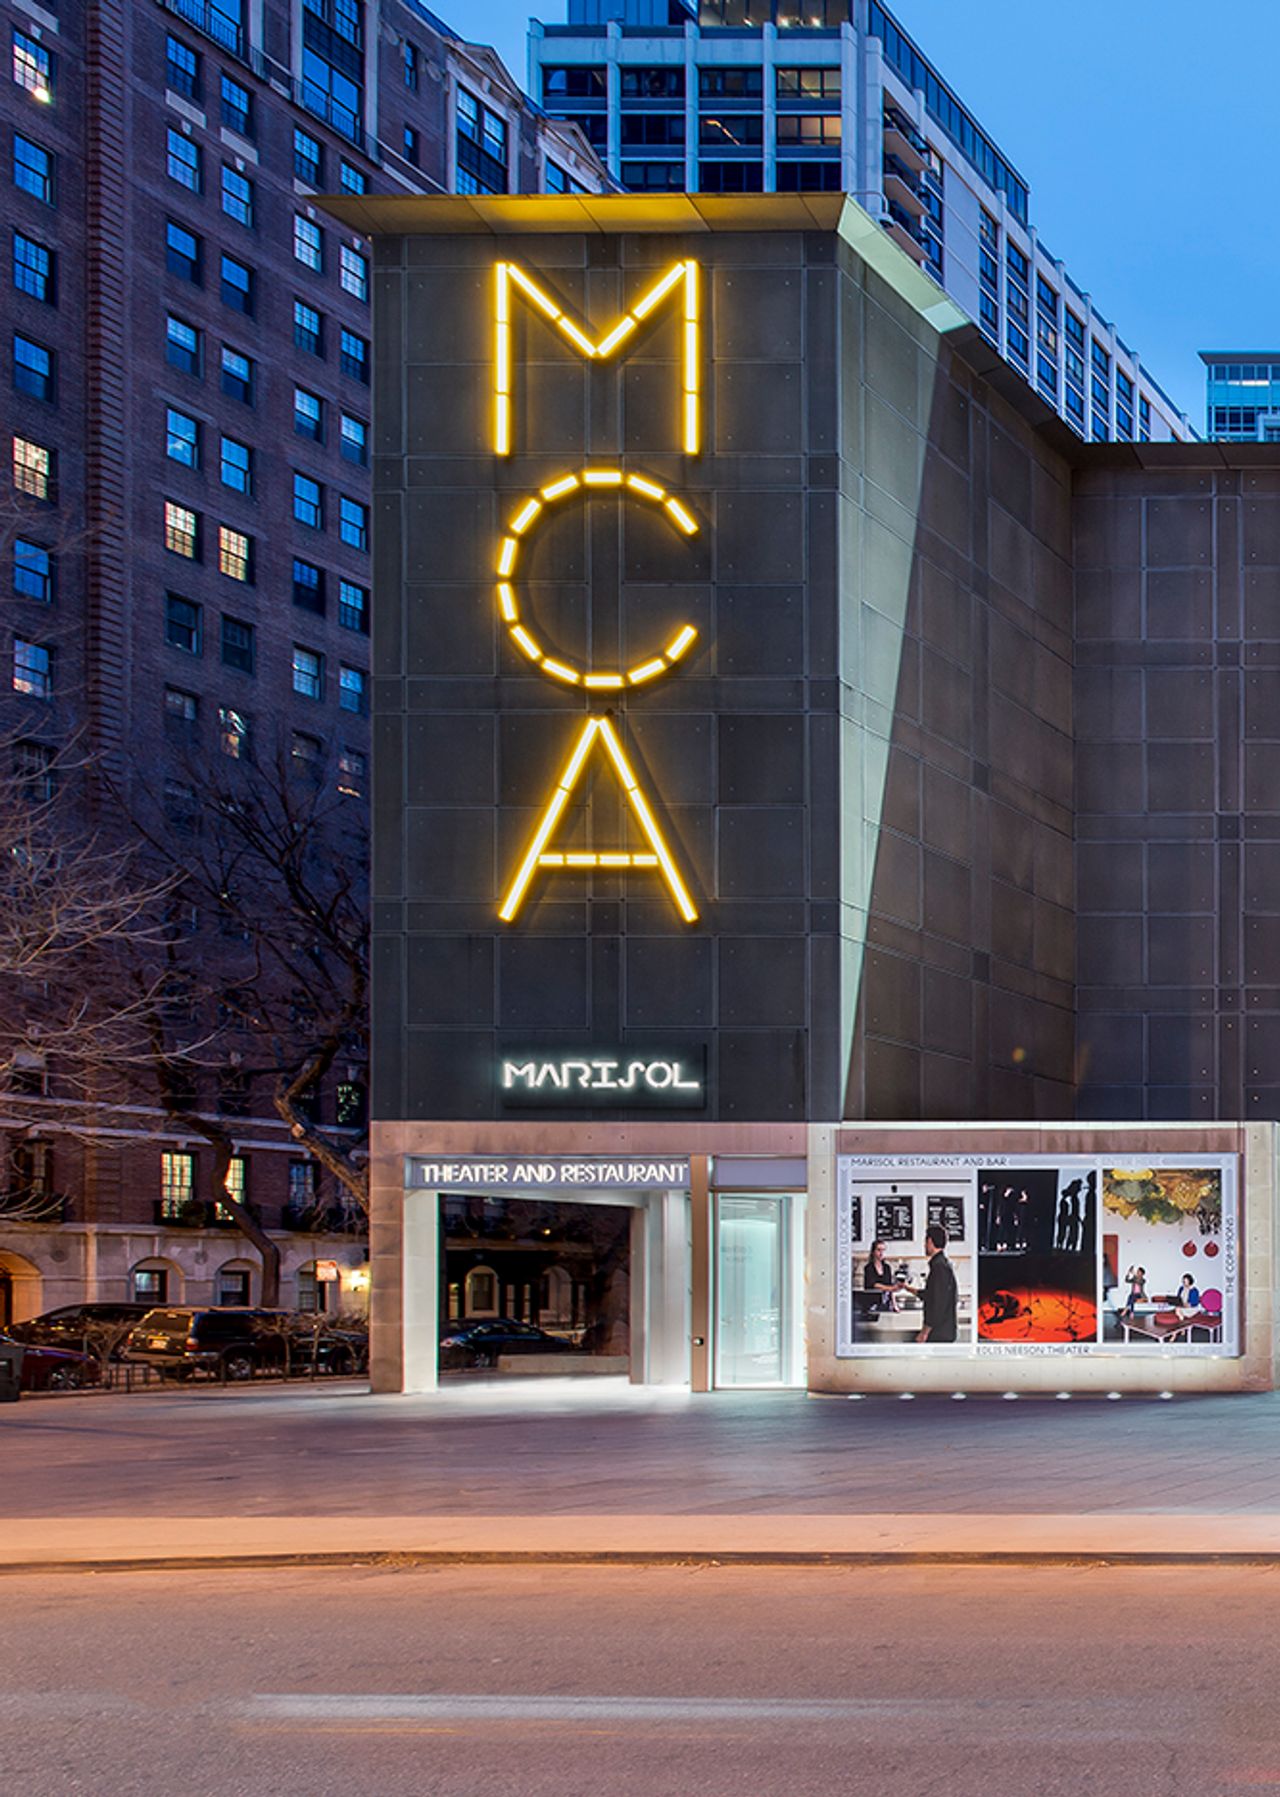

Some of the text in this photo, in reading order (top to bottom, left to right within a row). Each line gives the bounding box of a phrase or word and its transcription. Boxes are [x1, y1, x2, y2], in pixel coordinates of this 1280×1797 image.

[493, 259, 699, 923] MCA
[502, 1060, 700, 1090] MARISOL
[421, 1164, 689, 1184] THEATER AND RESTAURANT
[851, 1158, 1007, 1167] MARISOL RESTAURANT AND BAR
[1225, 1217, 1234, 1294] THE COMMONS
[1004, 1346, 1044, 1355] NEESON
[1047, 1346, 1091, 1355] THEATER
